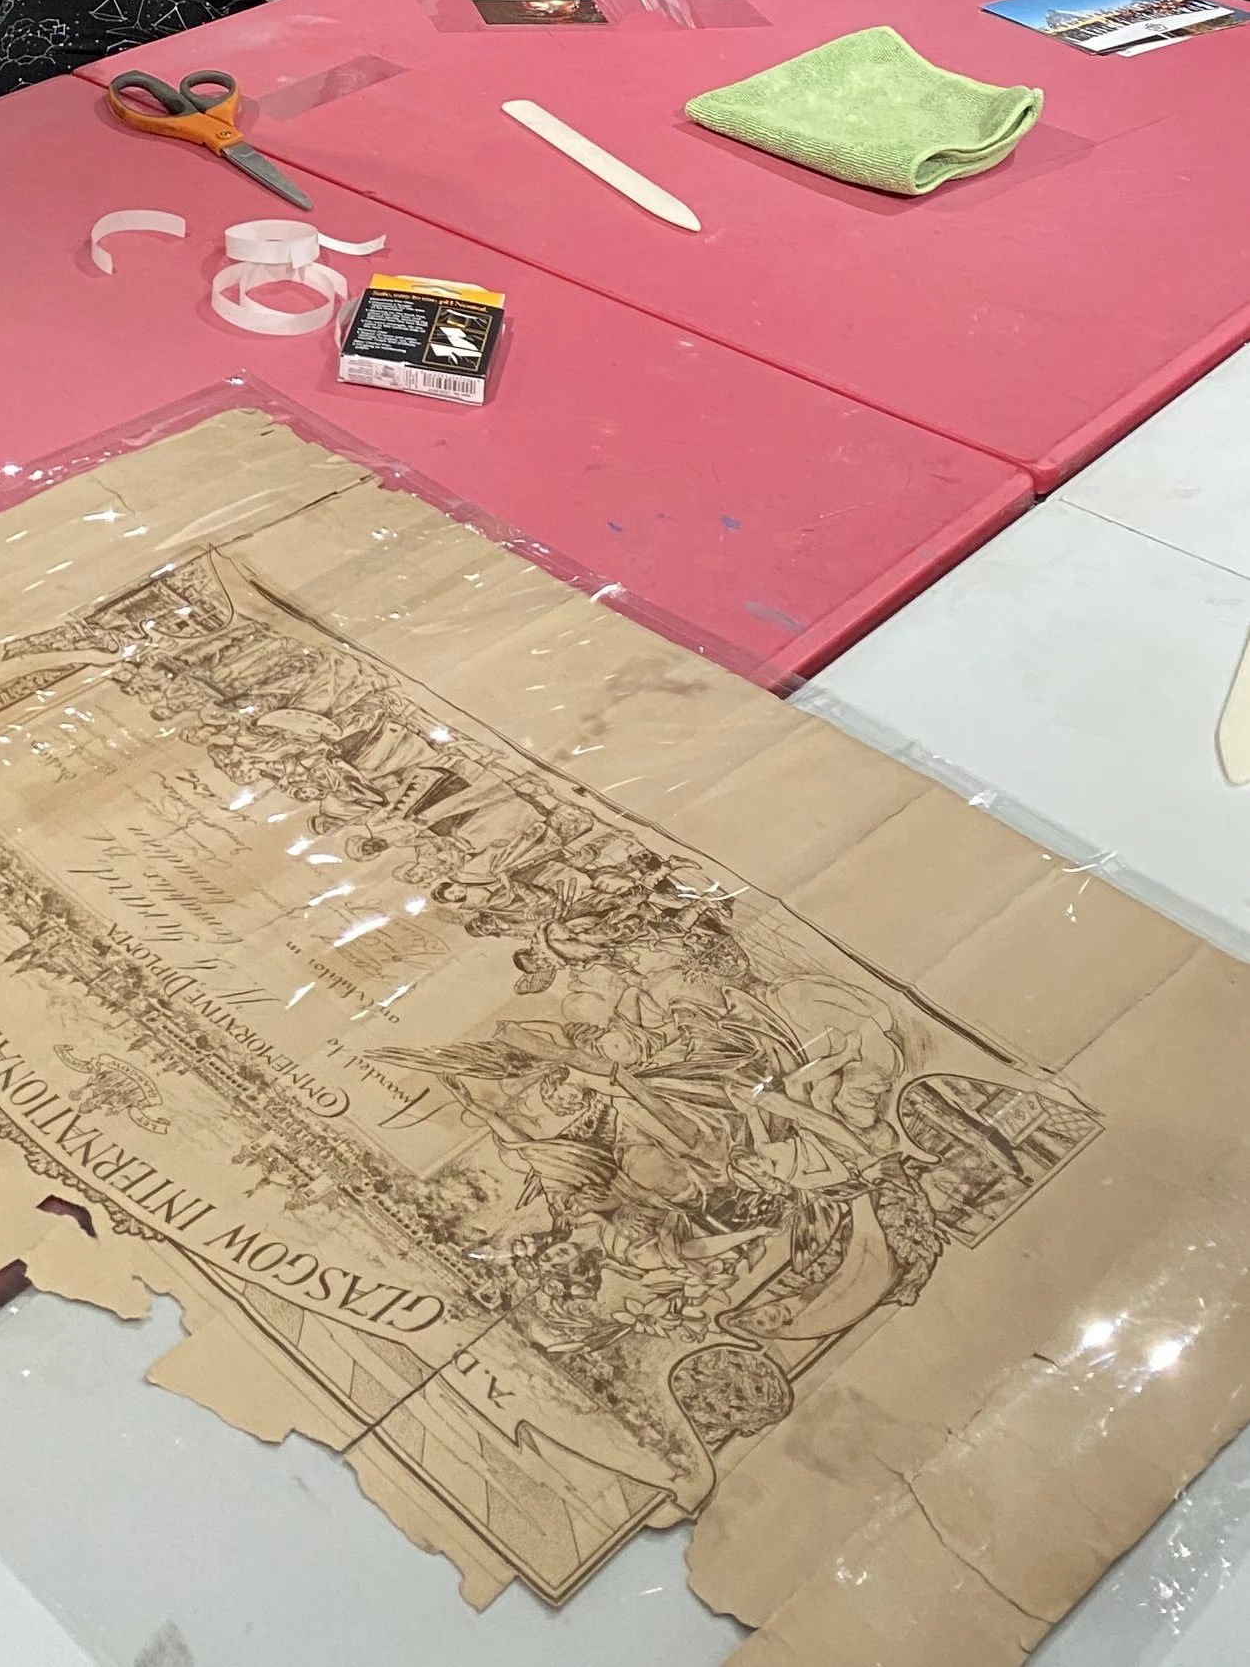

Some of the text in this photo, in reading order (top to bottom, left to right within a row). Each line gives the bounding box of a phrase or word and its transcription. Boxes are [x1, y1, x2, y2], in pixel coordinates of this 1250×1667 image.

[286, 939, 302, 954] in
[308, 958, 375, 1007] Exhibitor
[187, 985, 350, 1118] COMMEMORATIVE
[326, 1037, 447, 1129] Awarded to
[202, 1223, 446, 1334] GLASGOW
